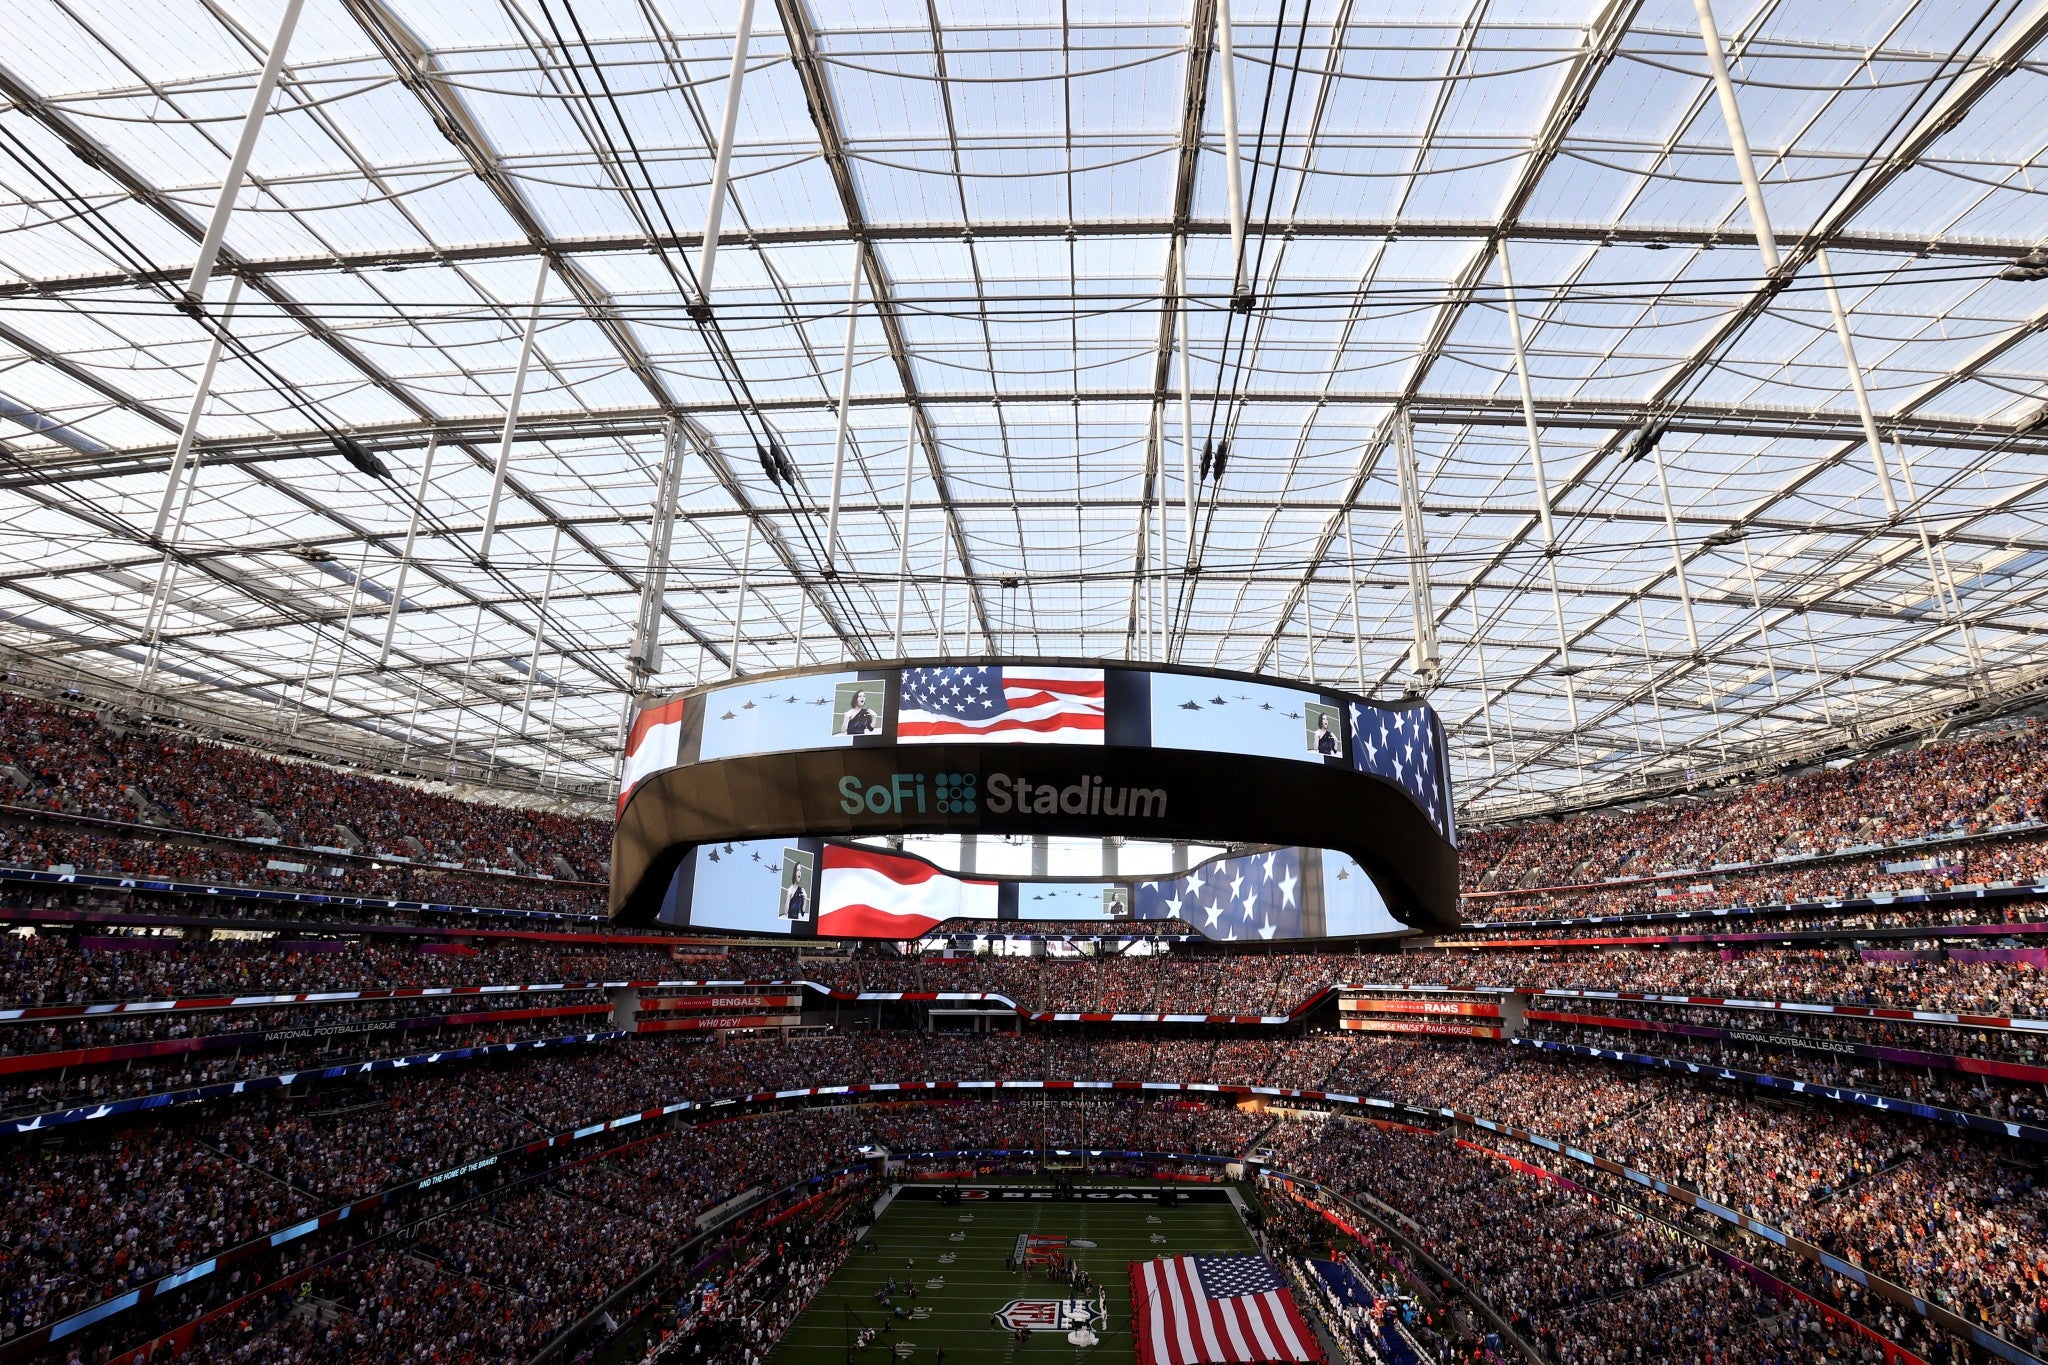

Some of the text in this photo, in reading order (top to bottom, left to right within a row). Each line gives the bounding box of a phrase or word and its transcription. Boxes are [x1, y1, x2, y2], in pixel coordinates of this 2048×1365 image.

[838, 773, 1168, 818] SoFi Stadium
[712, 998, 761, 1007] BENGALS
[1424, 1003, 1458, 1013] RAMS
[265, 1021, 397, 1041] NATIONAL FOOTBALL LEAGUE
[699, 1018, 741, 1028] WHO DEY!
[1371, 1023, 1473, 1036] WHOSE HOUSE? RAMS HOUSE!
[1730, 1032, 1856, 1054] NATIONAL FOOTBALL LEAGUE
[418, 1156, 498, 1190] AND THE HOME OF THE BRAVE?
[1008, 1302, 1056, 1328] NFL
